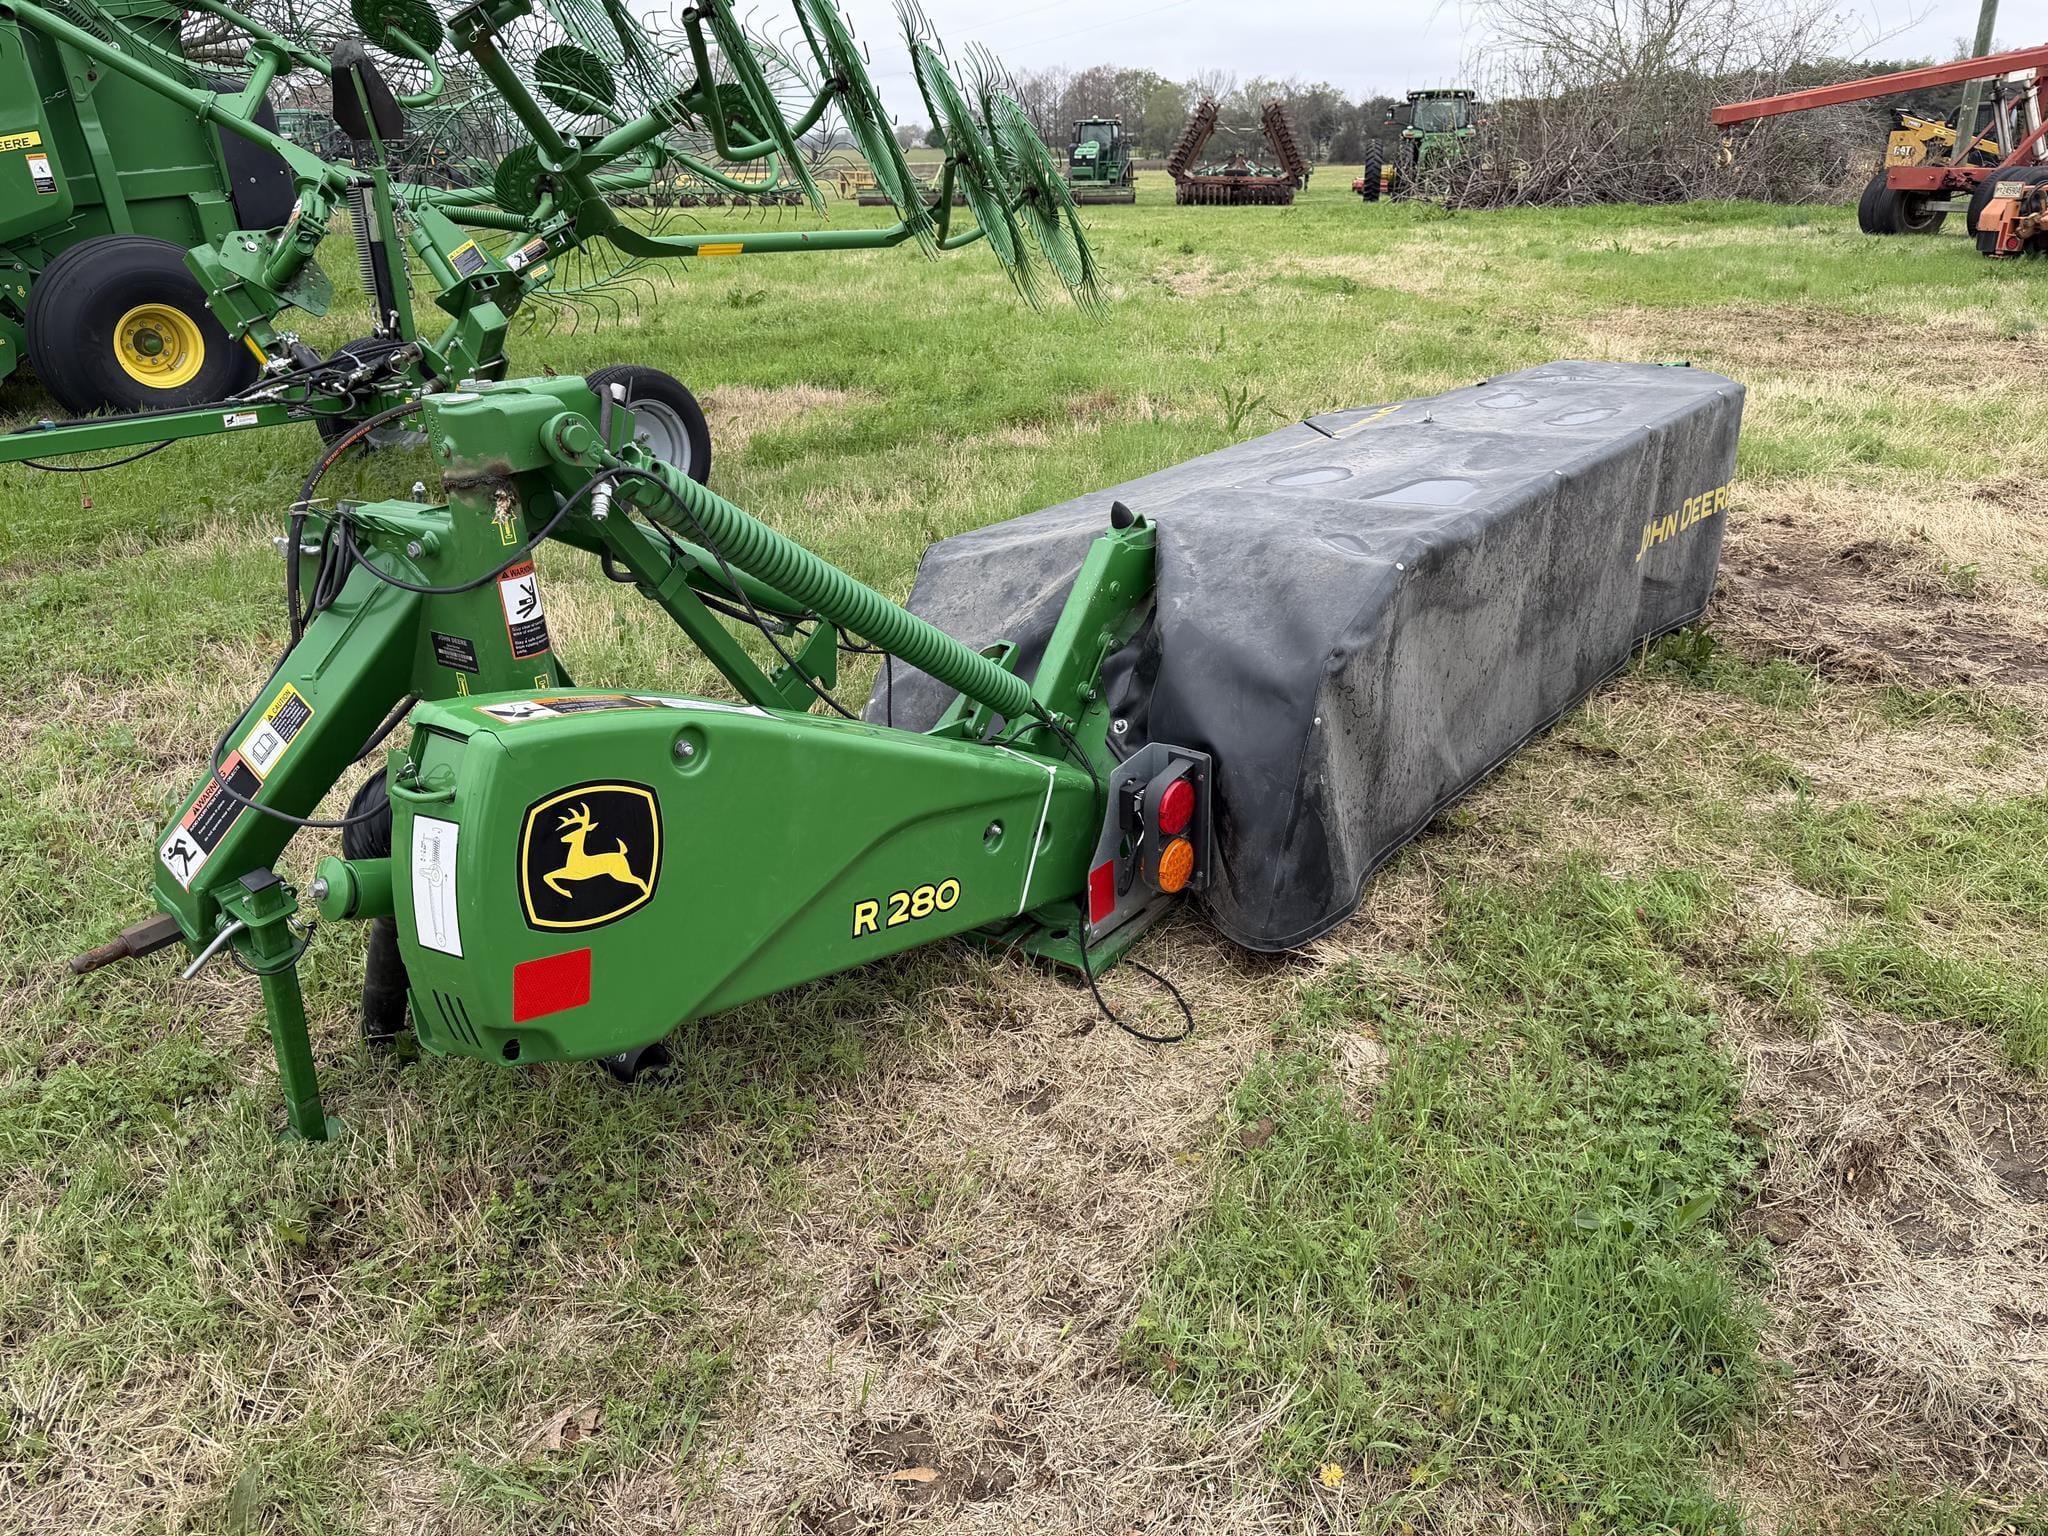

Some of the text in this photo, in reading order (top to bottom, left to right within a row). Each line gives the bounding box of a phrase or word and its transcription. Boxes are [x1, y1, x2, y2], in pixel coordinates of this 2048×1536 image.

[1893, 145, 1911, 156] CAT
[1635, 510, 1679, 563] JOHN
[270, 688, 292, 714] CAUTION
[196, 769, 227, 808] WARNIG
[852, 877, 961, 939] R 280
